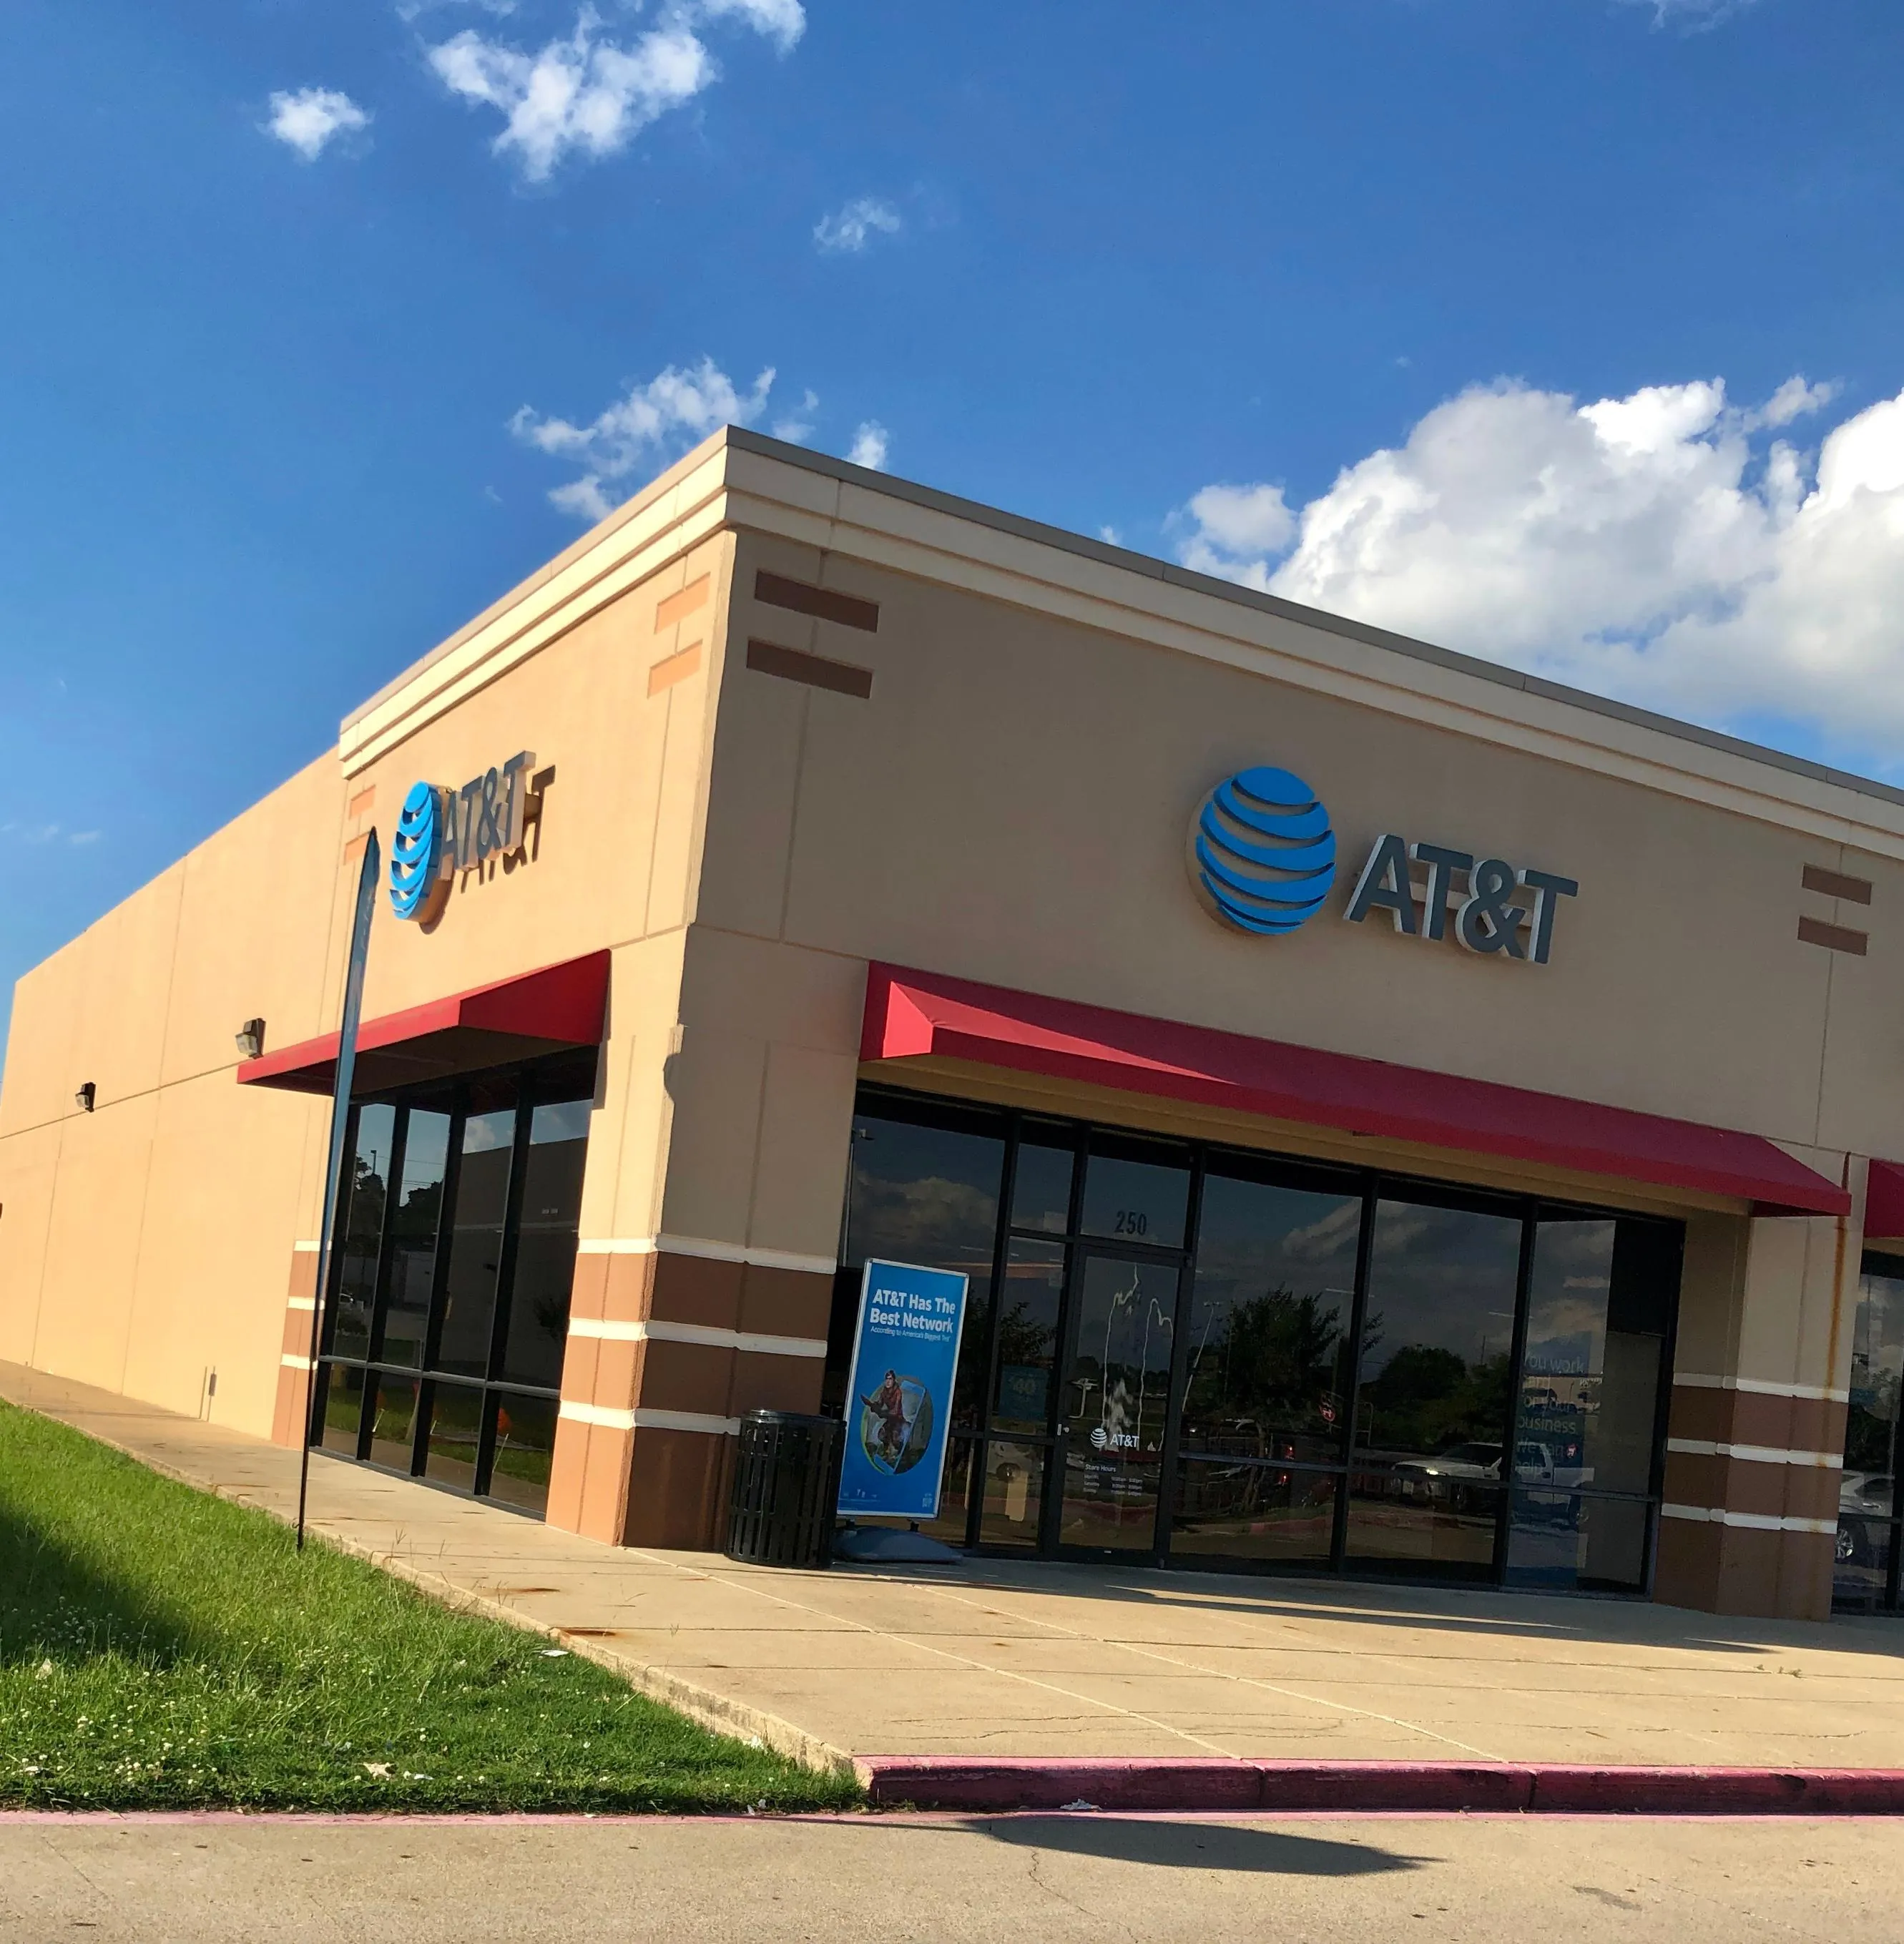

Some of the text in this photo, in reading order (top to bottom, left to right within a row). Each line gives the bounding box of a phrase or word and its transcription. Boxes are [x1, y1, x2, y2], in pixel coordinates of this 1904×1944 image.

[438, 750, 536, 880] AT&T
[1343, 834, 1579, 964] AT&T
[1114, 1210, 1147, 1235] 250
[872, 1288, 956, 1315] AT&T Has The
[870, 1307, 953, 1333] Best Network
[870, 1326, 895, 1336] According
[1550, 1355, 1585, 1373] work
[1109, 1433, 1139, 1448] AT&T
